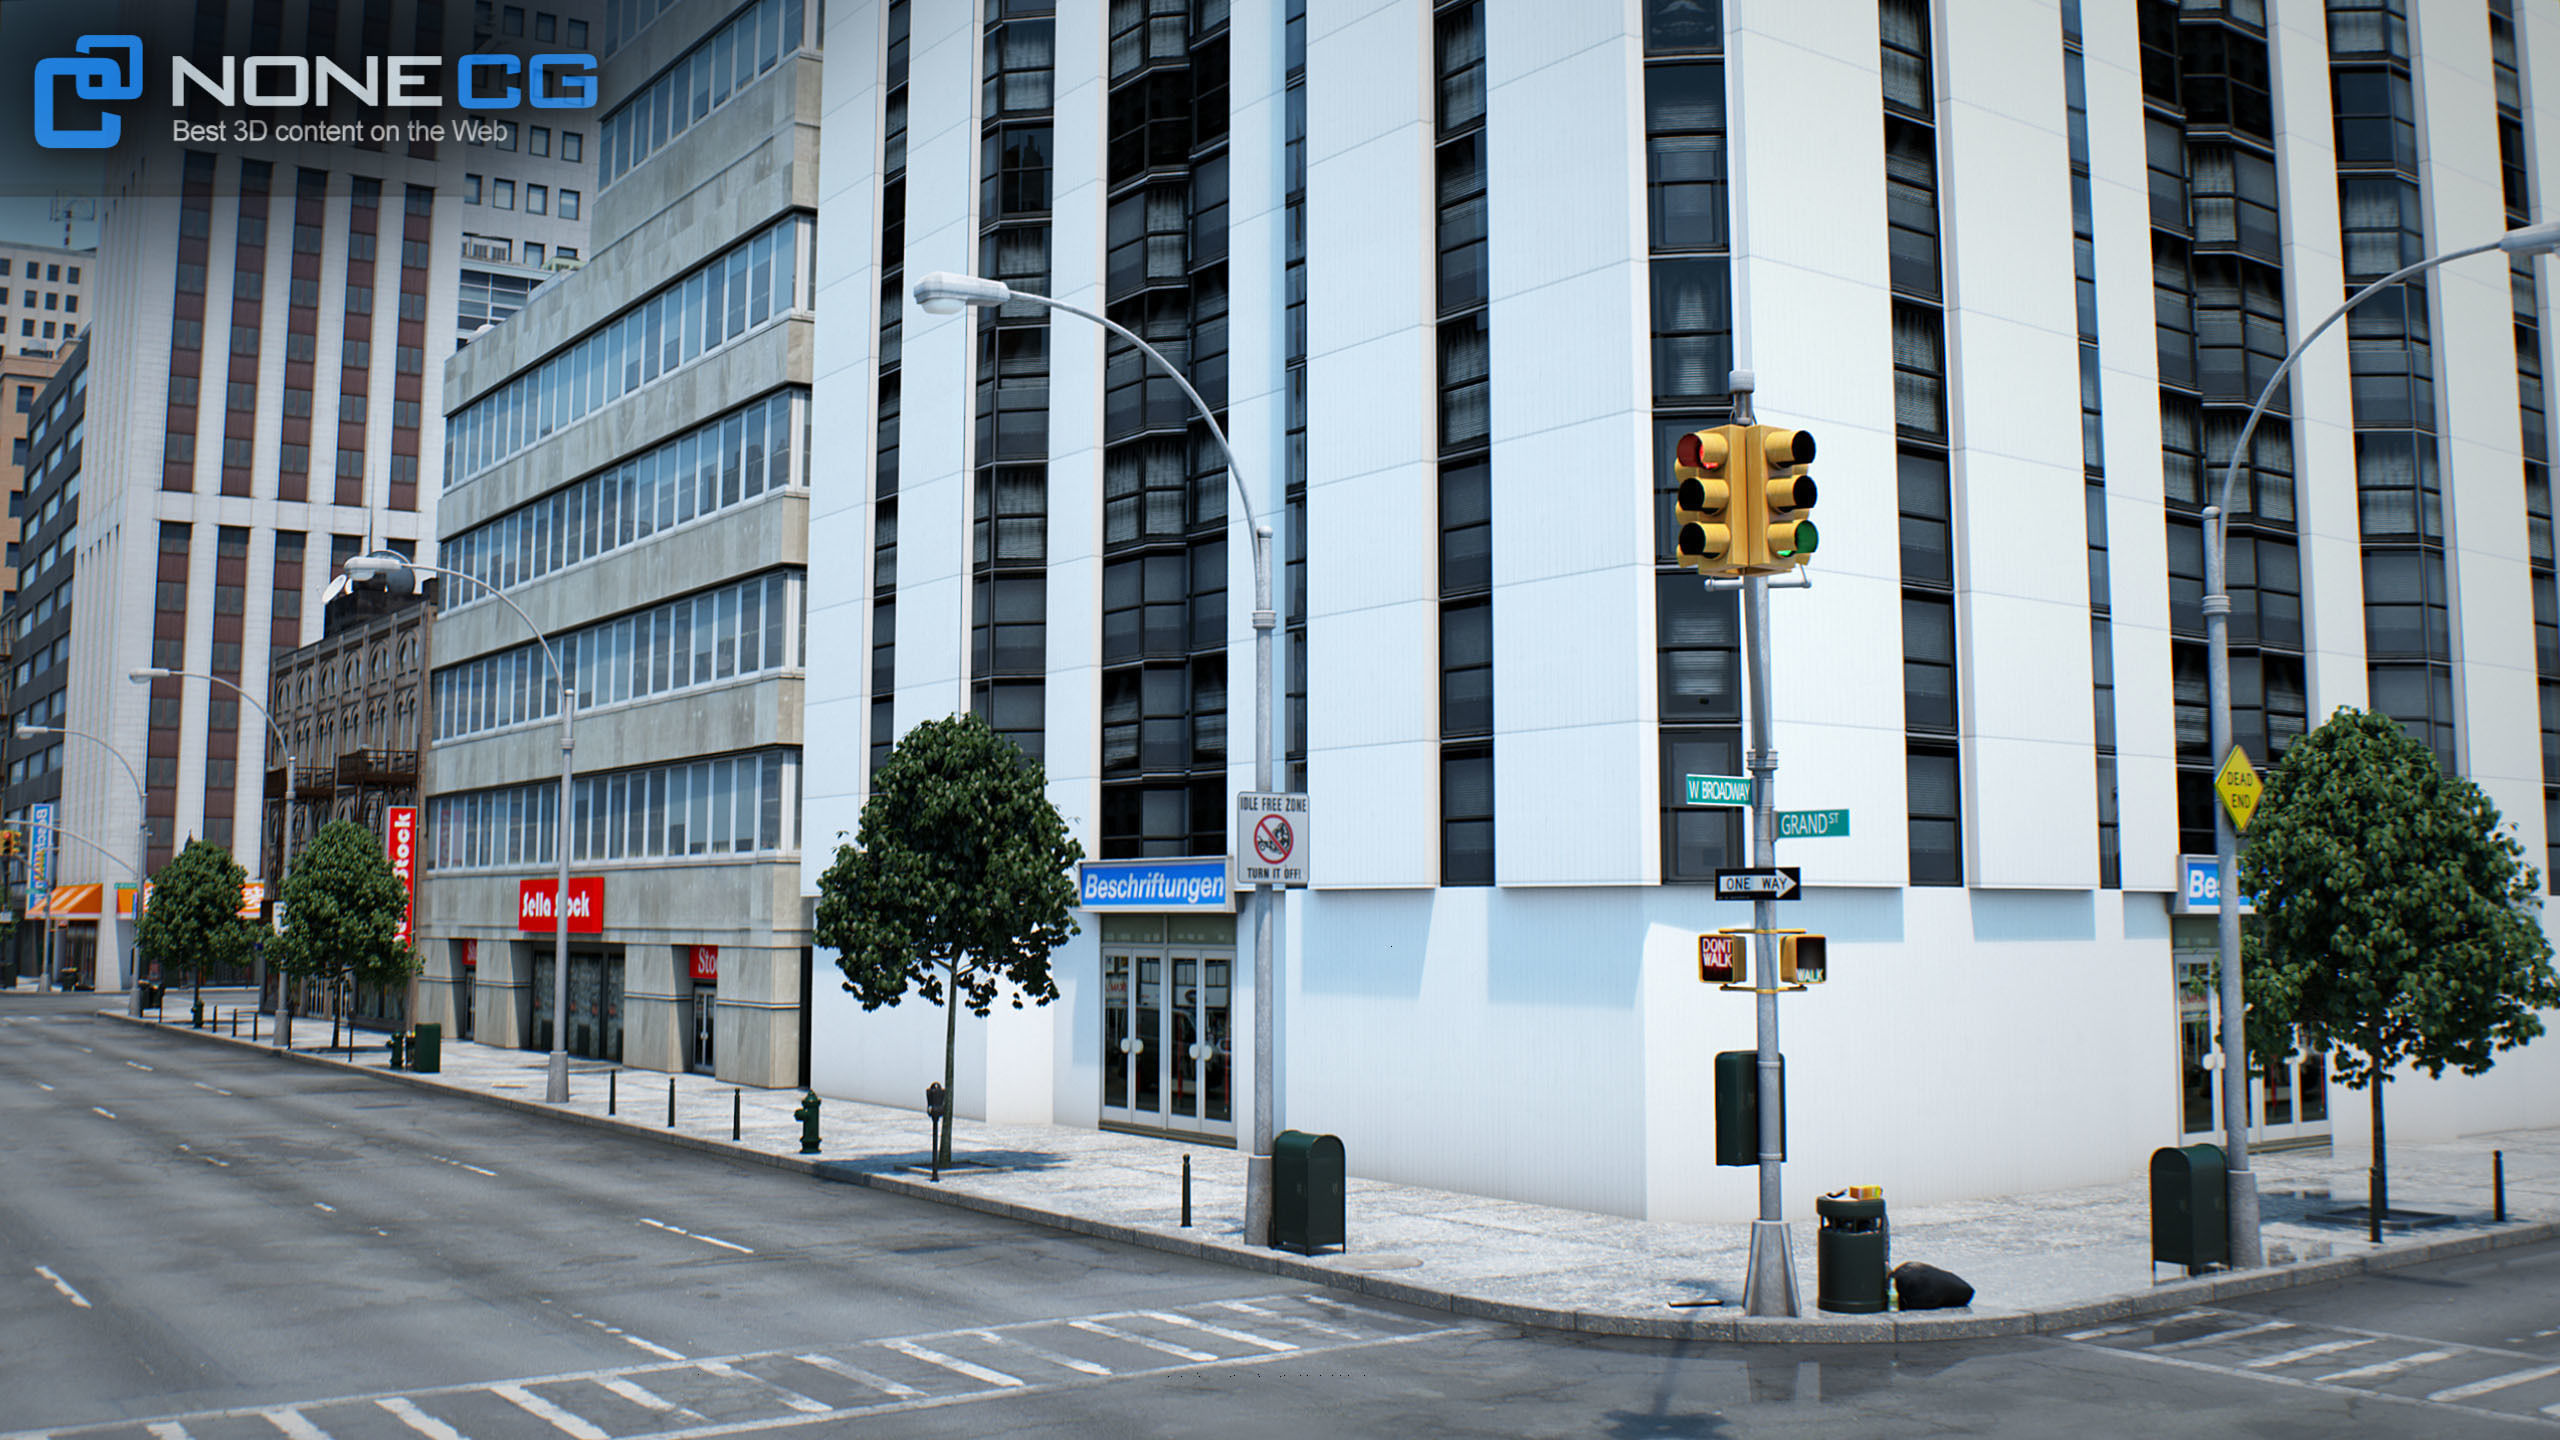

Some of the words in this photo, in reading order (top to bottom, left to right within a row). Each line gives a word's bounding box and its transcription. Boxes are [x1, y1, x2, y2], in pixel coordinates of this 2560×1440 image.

[2226, 771, 2253, 787] DEAD
[1689, 780, 1699, 799] W
[1701, 781, 1751, 802] BROADWAY
[1240, 796, 1259, 812] IDLE
[1262, 797, 1282, 812] FREE
[1285, 798, 1307, 813] ZONE
[2231, 793, 2252, 809] END
[1781, 814, 1828, 835] GRAND
[1247, 867, 1269, 880] TURN
[1272, 868, 1281, 880] IT
[1283, 868, 1302, 880] OFF!
[1085, 872, 1224, 904] Beschriftungen
[1726, 877, 1750, 890] ONE
[1761, 876, 1788, 890] WAY
[523, 891, 551, 917] Sella
[554, 889, 590, 917] Sock
[1703, 938, 1733, 954] DONT
[1703, 953, 1733, 968] WALK
[1796, 968, 1823, 982] WALK
